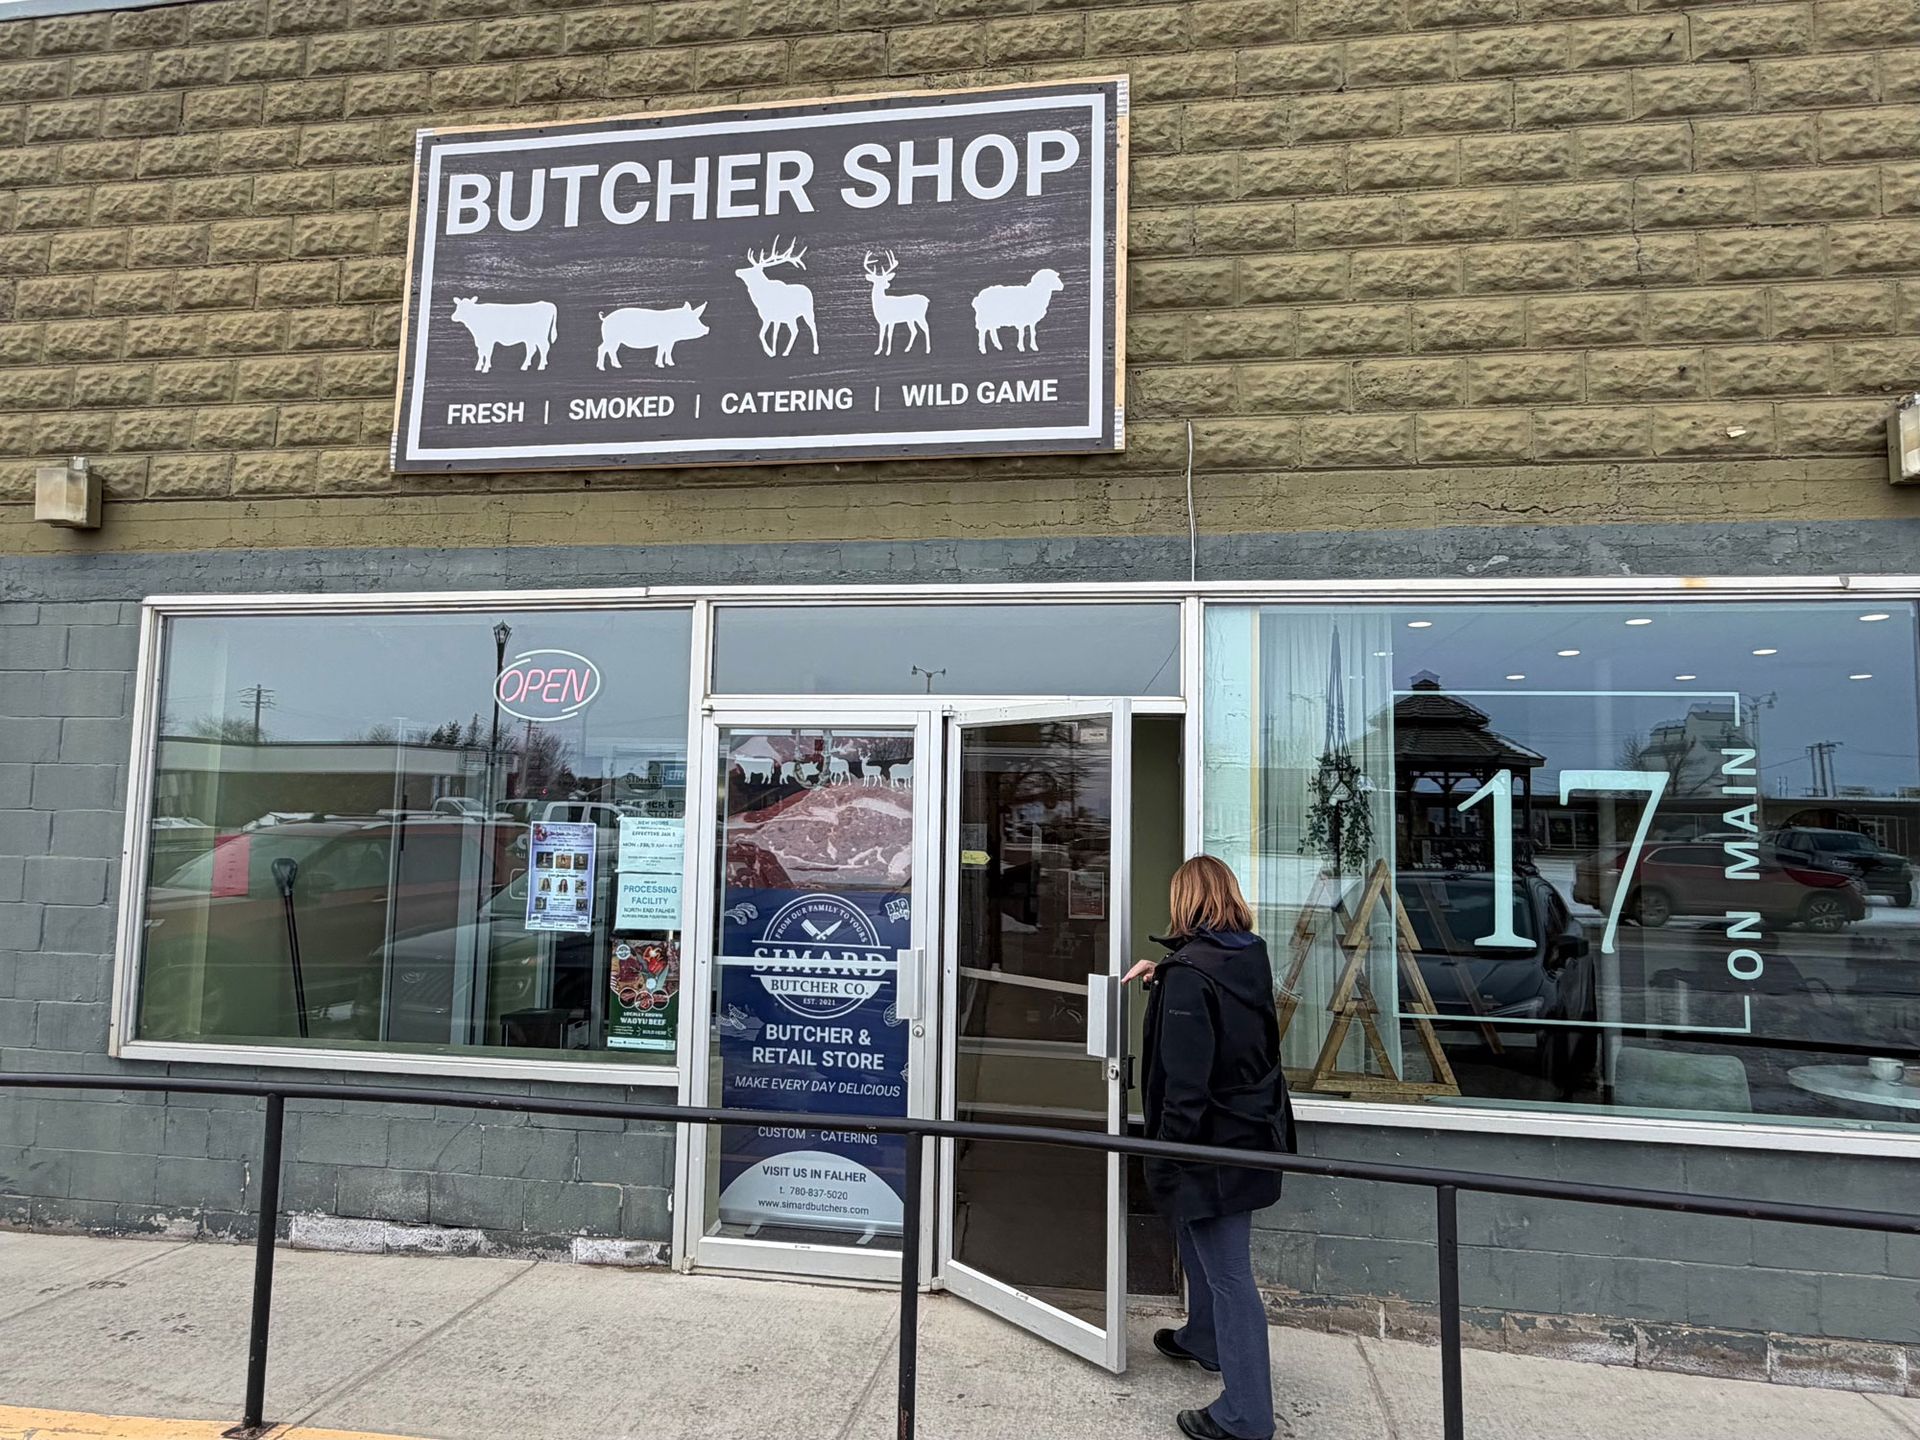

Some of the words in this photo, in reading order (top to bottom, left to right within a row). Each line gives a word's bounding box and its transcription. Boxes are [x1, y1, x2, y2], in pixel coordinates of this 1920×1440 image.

[446, 150, 815, 235] BUTCHER
[840, 130, 1080, 209] SHOP
[447, 402, 525, 425] FRESH
[568, 395, 675, 421] SMOKED
[720, 388, 853, 414] CATERING
[902, 382, 969, 407] WILD
[976, 379, 1059, 404] GAME
[499, 668, 591, 703] OPEN
[1720, 748, 1761, 880] MAIN
[1456, 769, 1671, 954] 17
[623, 885, 678, 894] PROCESSING
[631, 896, 669, 905] FACILITY
[775, 918, 792, 939] FROM
[791, 907, 807, 920] OUR
[808, 904, 839, 914] FAMILY
[839, 909, 850, 920] TO
[849, 917, 869, 943] YOURS
[1726, 911, 1764, 980] ON
[753, 947, 887, 977] SIMARD
[770, 979, 839, 994] BUTCHER
[844, 982, 869, 996] CO.
[802, 997, 818, 1005] EST.
[819, 998, 836, 1006] 2021
[620, 1017, 648, 1025] WAGYU
[648, 1018, 667, 1026] BEEF
[765, 1023, 854, 1045] BUTCHER
[858, 1028, 872, 1046] &
[752, 1046, 817, 1066] RETAIL
[822, 1050, 885, 1070] STORE
[734, 1075, 769, 1089] MAKE
[771, 1077, 810, 1091] EVERY
[811, 1080, 836, 1092] DAY
[838, 1082, 901, 1097] DELICIOUS
[758, 1126, 806, 1140] CUSTOM
[820, 1130, 878, 1145] CATERING
[762, 1165, 790, 1177] VISIT
[793, 1167, 808, 1179] US
[810, 1168, 822, 1179] IN
[824, 1170, 867, 1183] FALHER
[789, 1186, 848, 1201] 780-837-5020
[758, 1199, 870, 1216] www.simardbutchers.com
